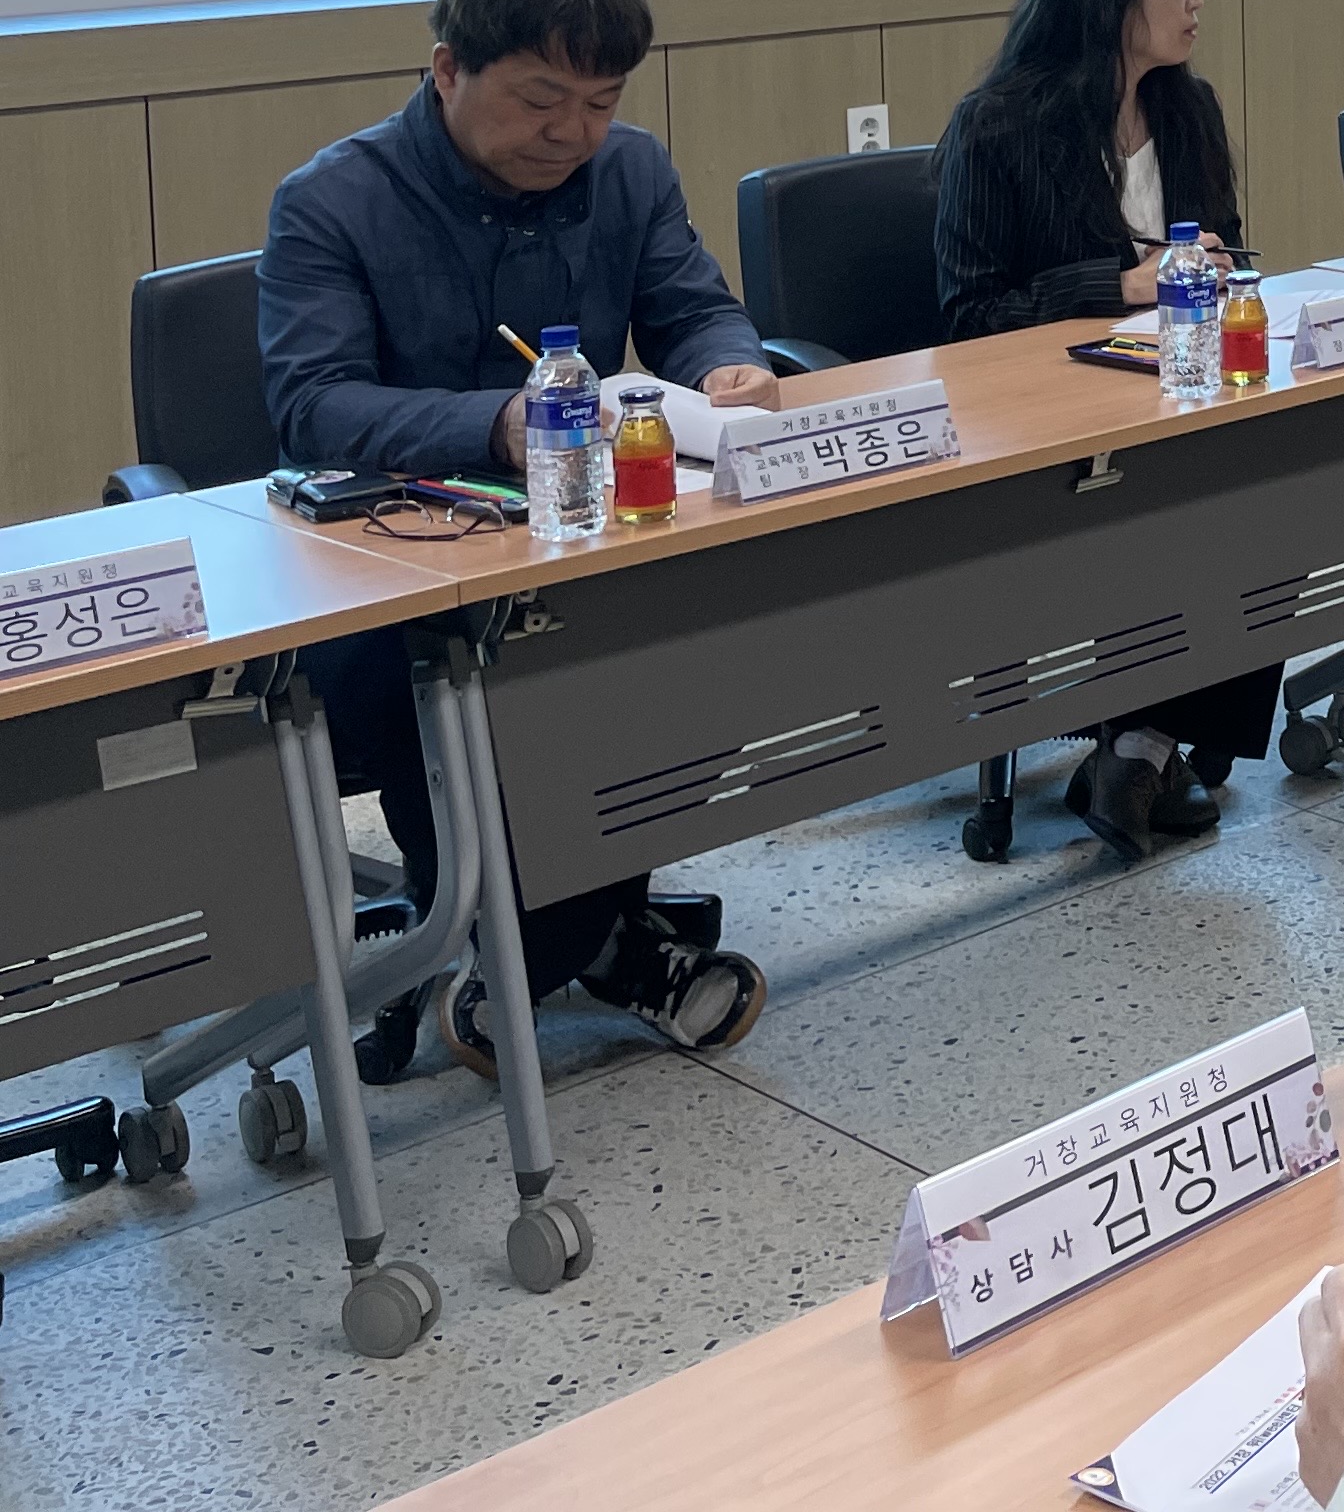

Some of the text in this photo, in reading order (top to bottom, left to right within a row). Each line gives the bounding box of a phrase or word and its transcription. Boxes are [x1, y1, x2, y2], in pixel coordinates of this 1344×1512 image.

[754, 419, 930, 473] 교육재정 박종은
[781, 398, 898, 432] 거창교육지원청
[2, 562, 119, 600] 교육지원청
[0, 586, 161, 663] 홍성은
[1024, 1064, 1229, 1179] 거창교육지원청
[969, 1094, 1286, 1305] 상담사 김정대
